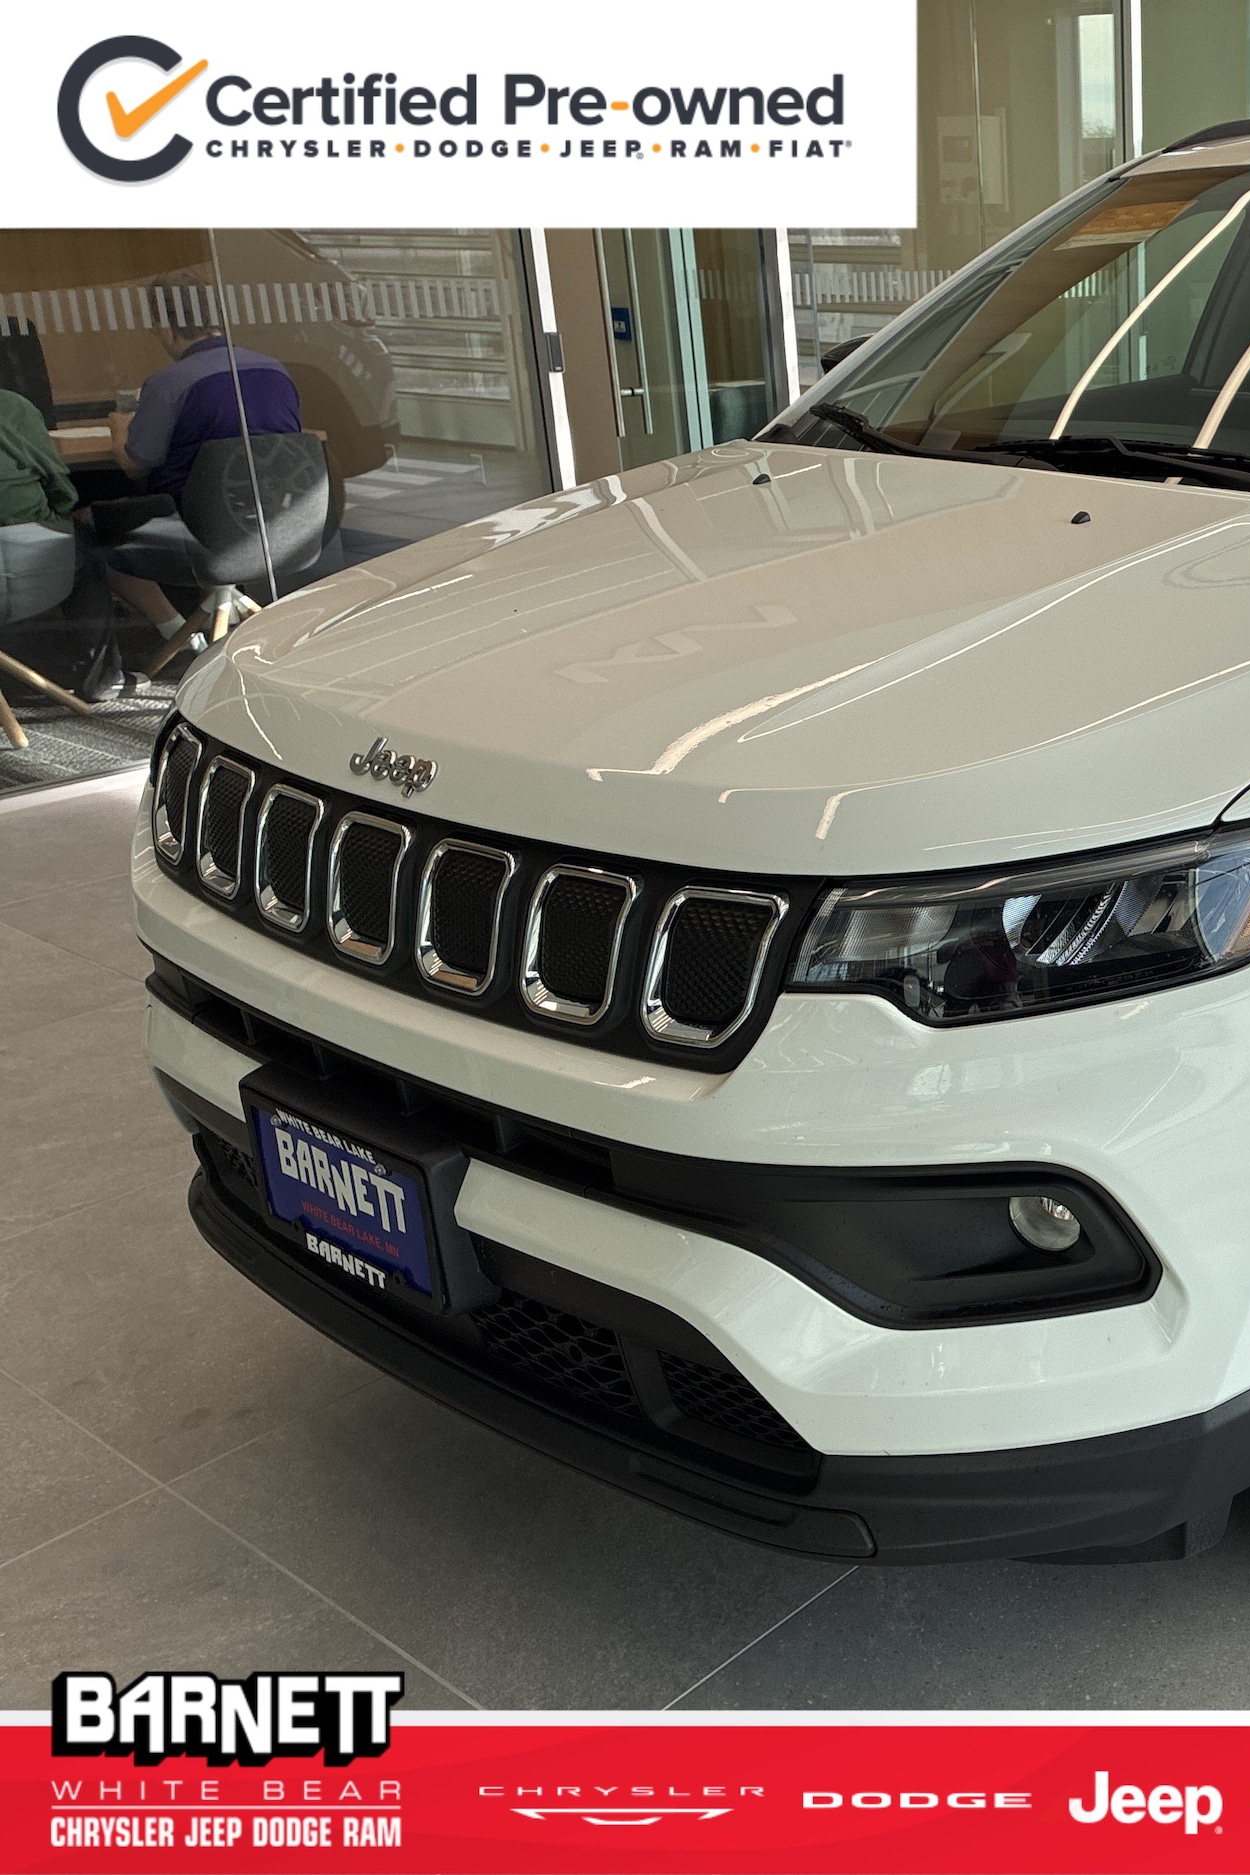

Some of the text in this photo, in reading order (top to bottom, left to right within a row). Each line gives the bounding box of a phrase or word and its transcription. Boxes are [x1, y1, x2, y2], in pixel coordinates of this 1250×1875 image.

[350, 737, 438, 798] Jeep
[275, 1108, 377, 1164] WHITE BEAR LAKE
[275, 1127, 406, 1234] BARNETT
[301, 1200, 329, 1224] WHITE
[330, 1213, 355, 1236] BEAR
[306, 1233, 387, 1289] BARNETT
